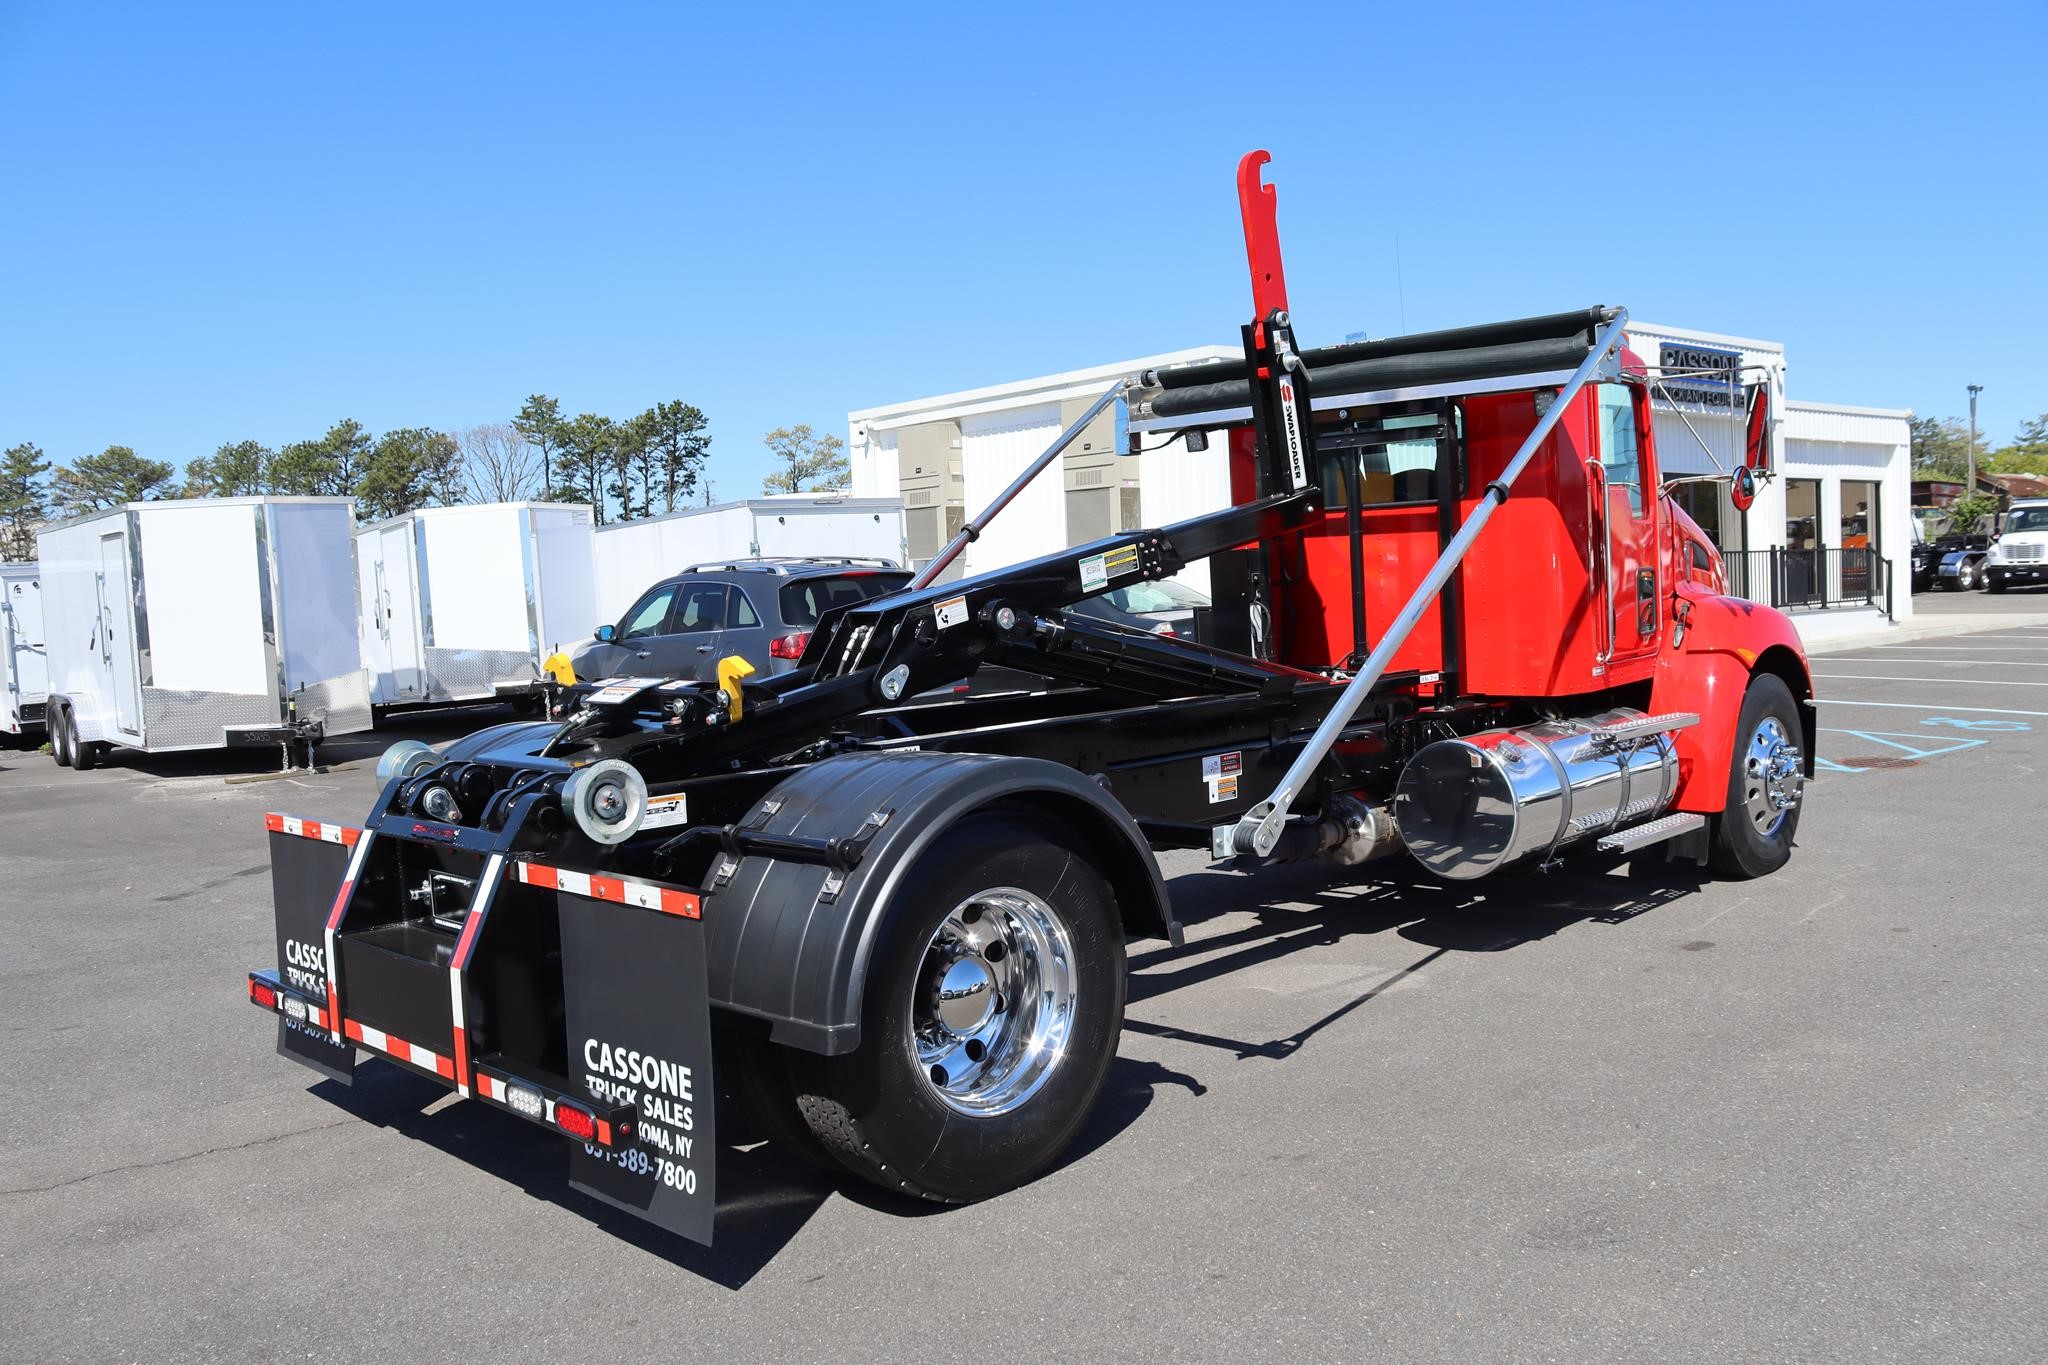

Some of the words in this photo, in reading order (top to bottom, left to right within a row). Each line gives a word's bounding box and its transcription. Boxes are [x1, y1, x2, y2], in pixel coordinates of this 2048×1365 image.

[1662, 349, 1744, 383] CASSONE
[1686, 388, 1705, 404] AND
[1285, 405, 1301, 479] SWAPLOADER
[584, 1038, 693, 1102] CASSONE
[643, 1093, 694, 1131] SALES
[675, 1134, 693, 1159] NY
